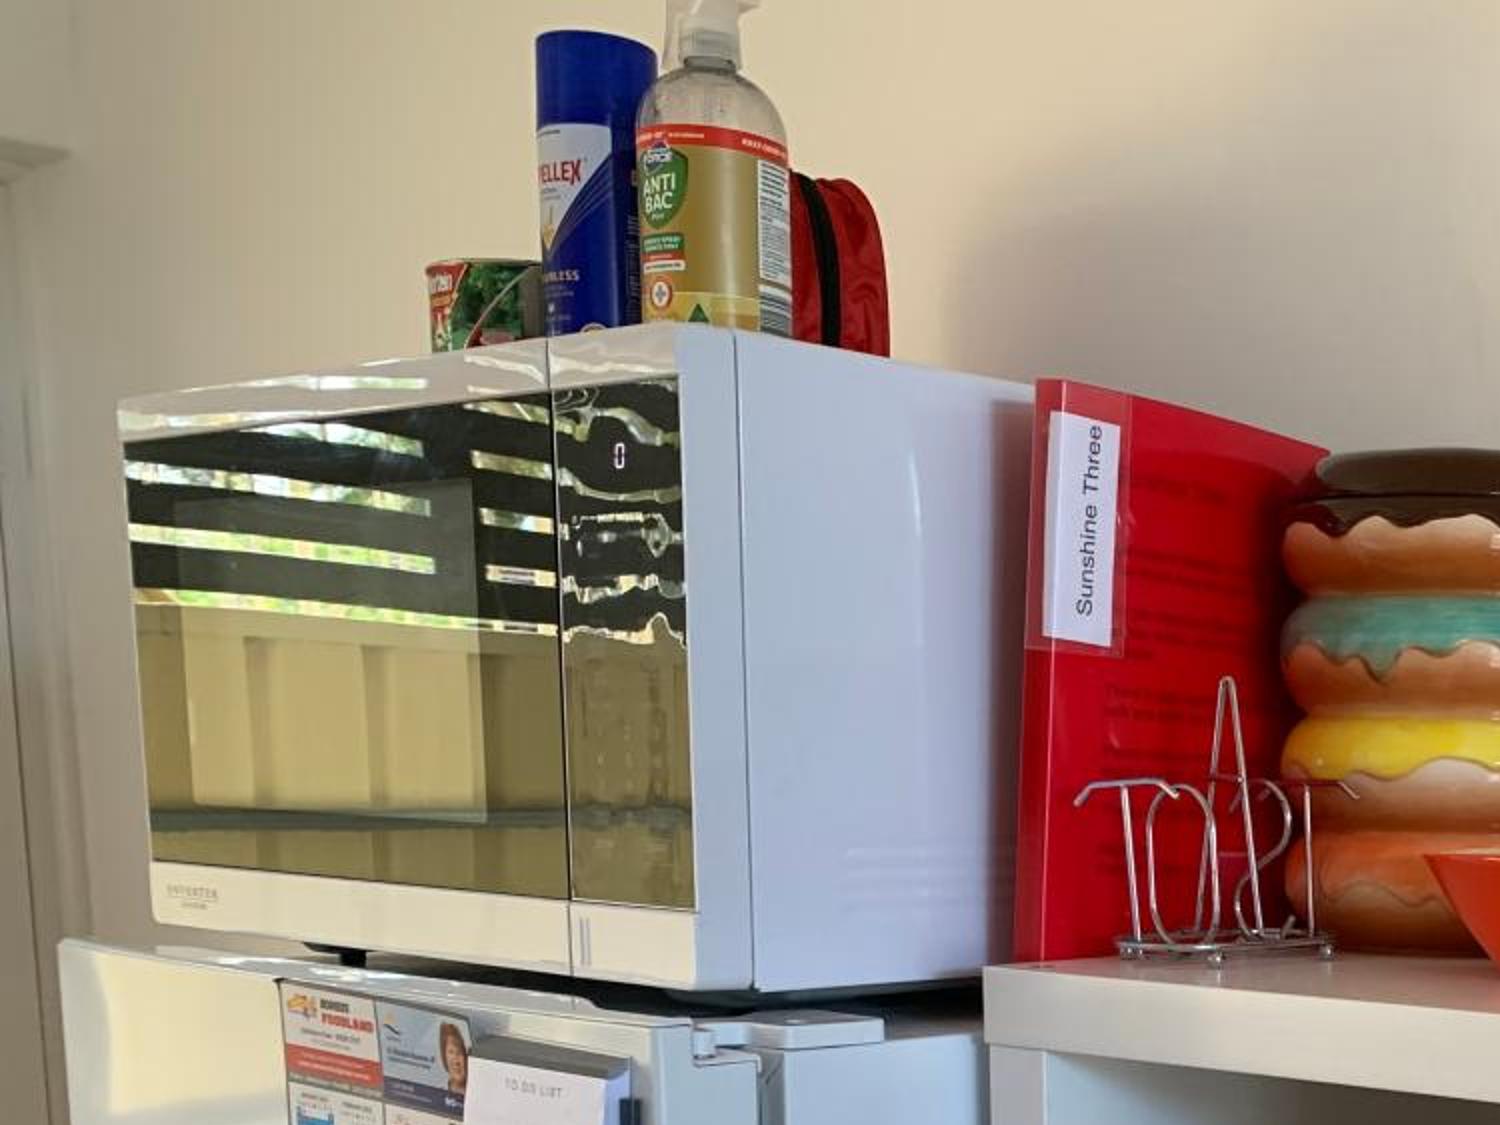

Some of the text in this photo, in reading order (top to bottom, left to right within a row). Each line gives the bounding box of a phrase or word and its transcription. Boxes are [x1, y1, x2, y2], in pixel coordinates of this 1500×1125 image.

[643, 172, 676, 198] ANTI
[645, 192, 673, 214] BAC
[1076, 425, 1102, 617] Sunshine Three
